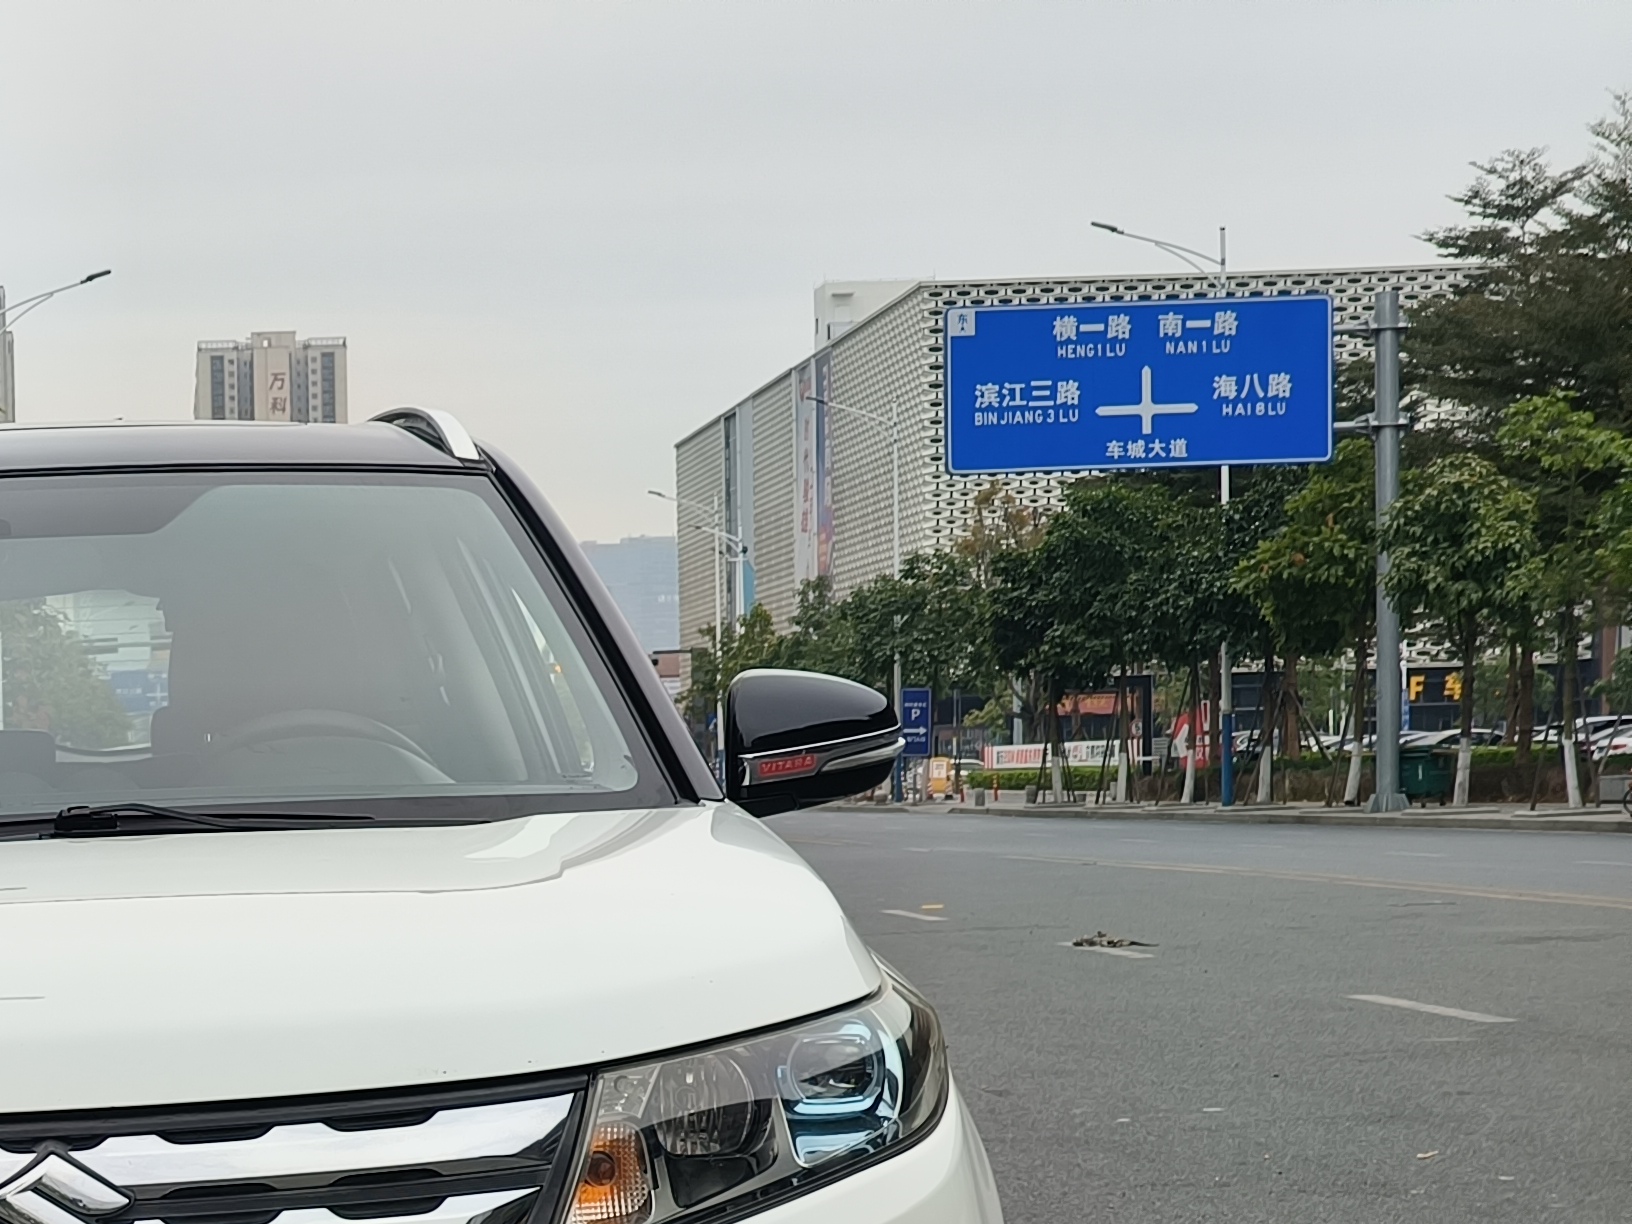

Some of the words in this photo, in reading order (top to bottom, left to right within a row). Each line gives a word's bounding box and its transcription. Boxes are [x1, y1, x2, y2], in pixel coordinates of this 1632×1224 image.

[1052, 313, 1132, 342] 横一路
[1158, 310, 1239, 338] 南一路
[974, 379, 1081, 407] 滨江三路
[1212, 372, 1292, 400] 海八路
[1105, 438, 1188, 460] 车城大道
[910, 708, 921, 721] P
[760, 756, 814, 773] VITARA
